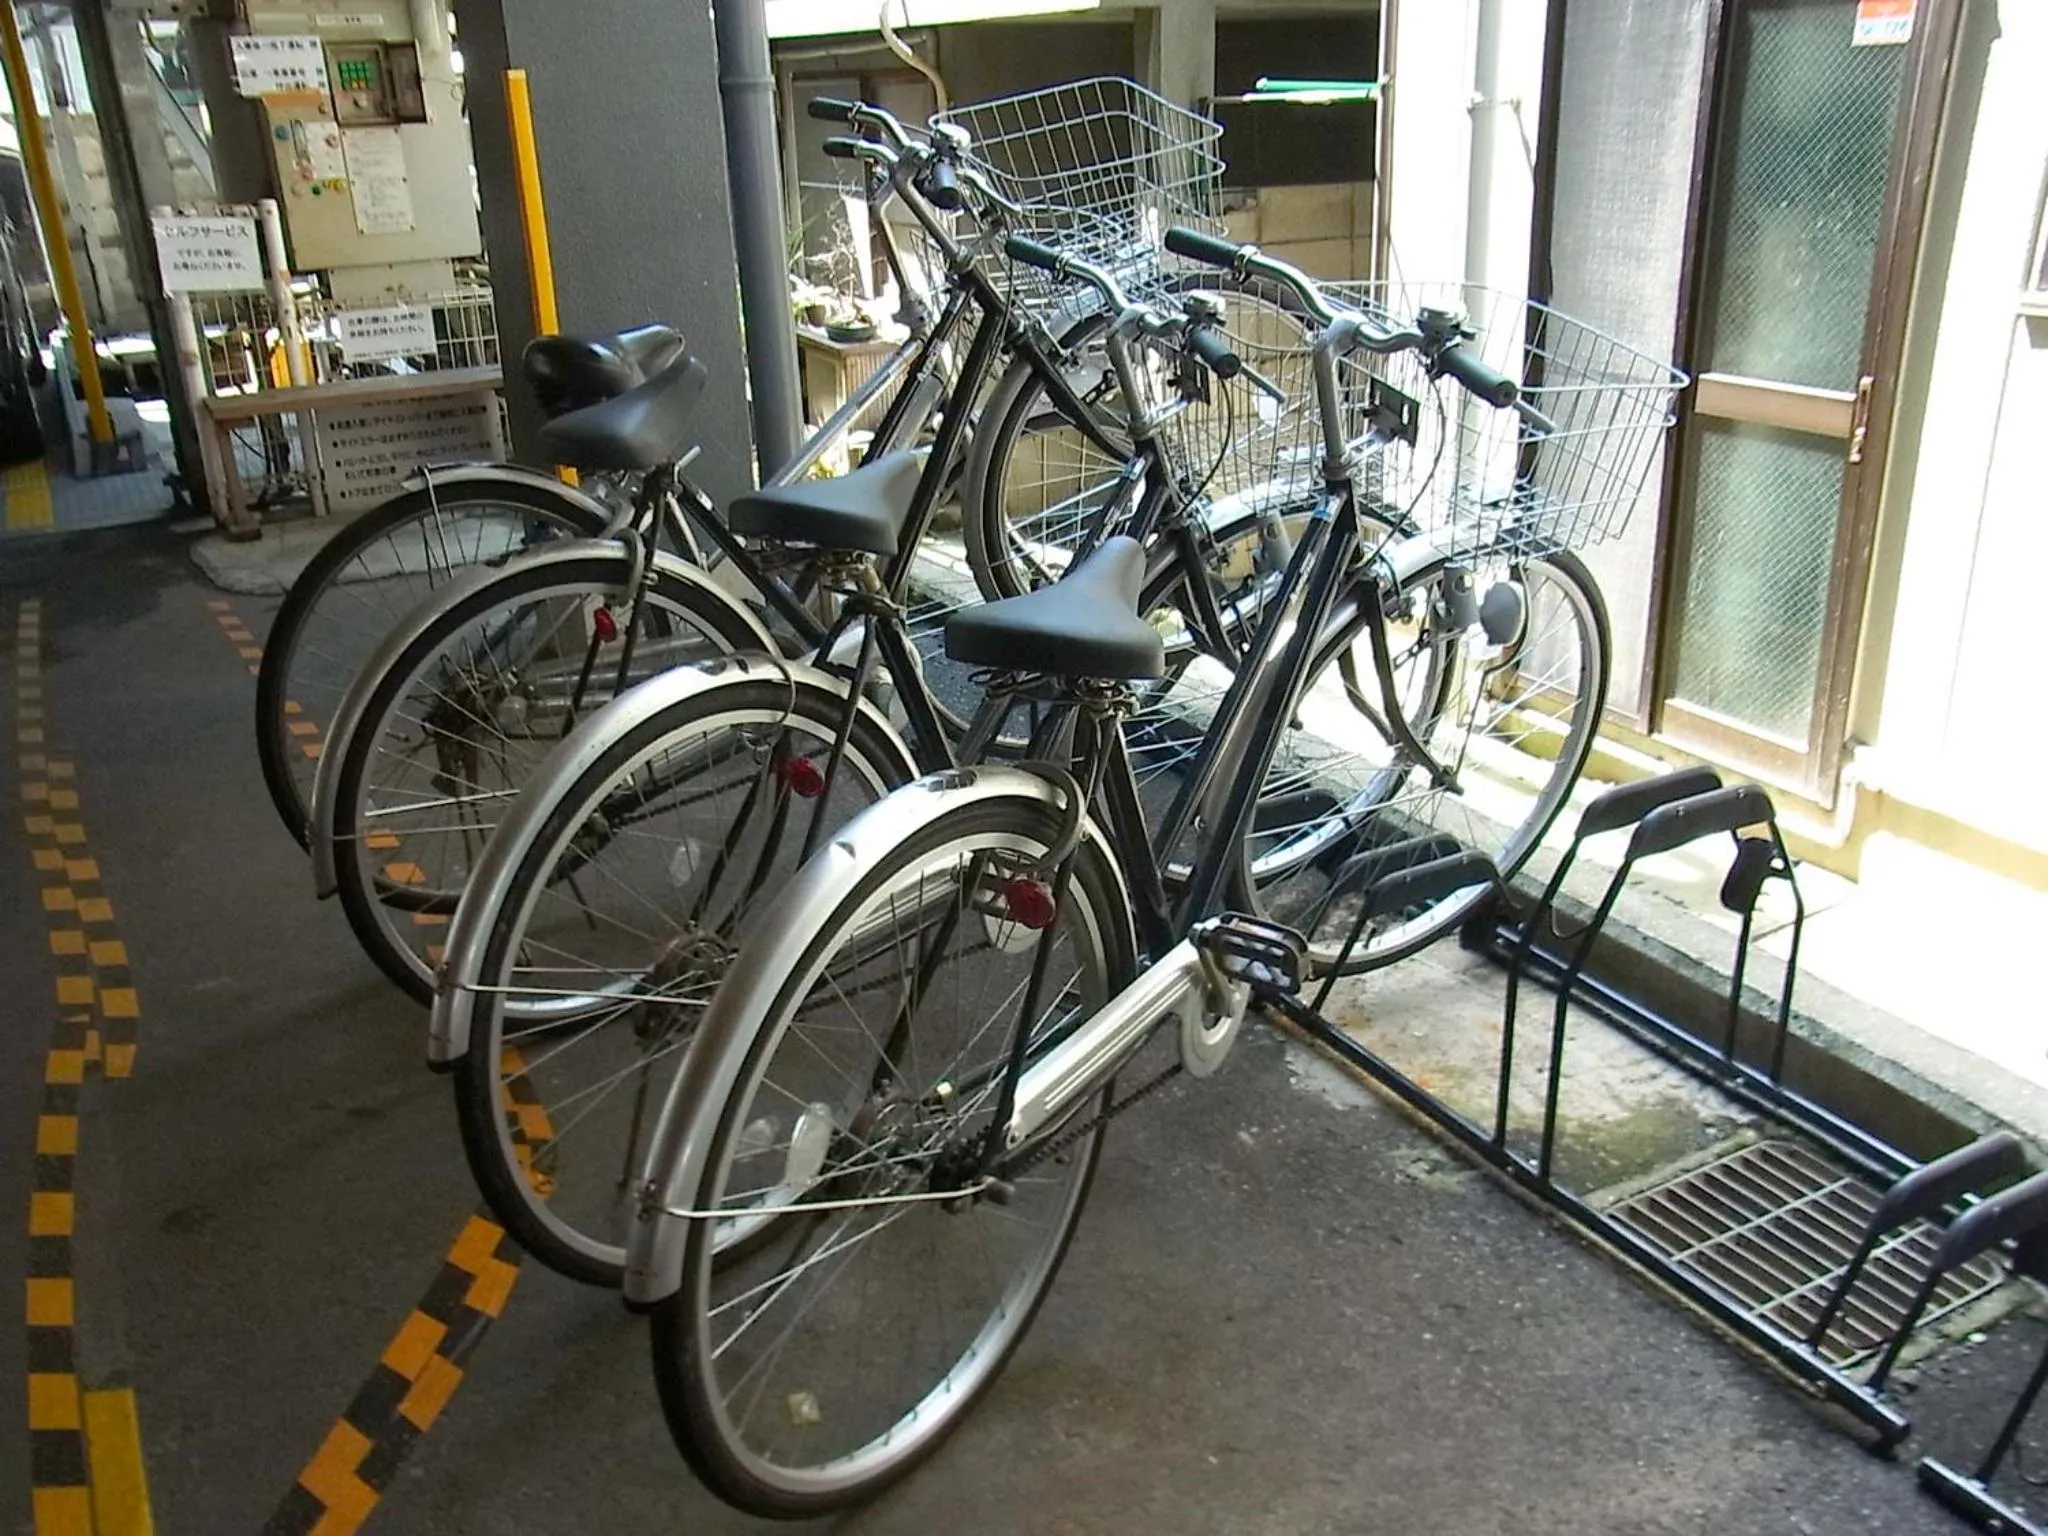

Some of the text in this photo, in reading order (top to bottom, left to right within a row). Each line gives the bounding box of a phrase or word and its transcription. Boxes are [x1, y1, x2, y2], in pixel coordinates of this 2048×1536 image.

[164, 224, 249, 239] セルフサービス
